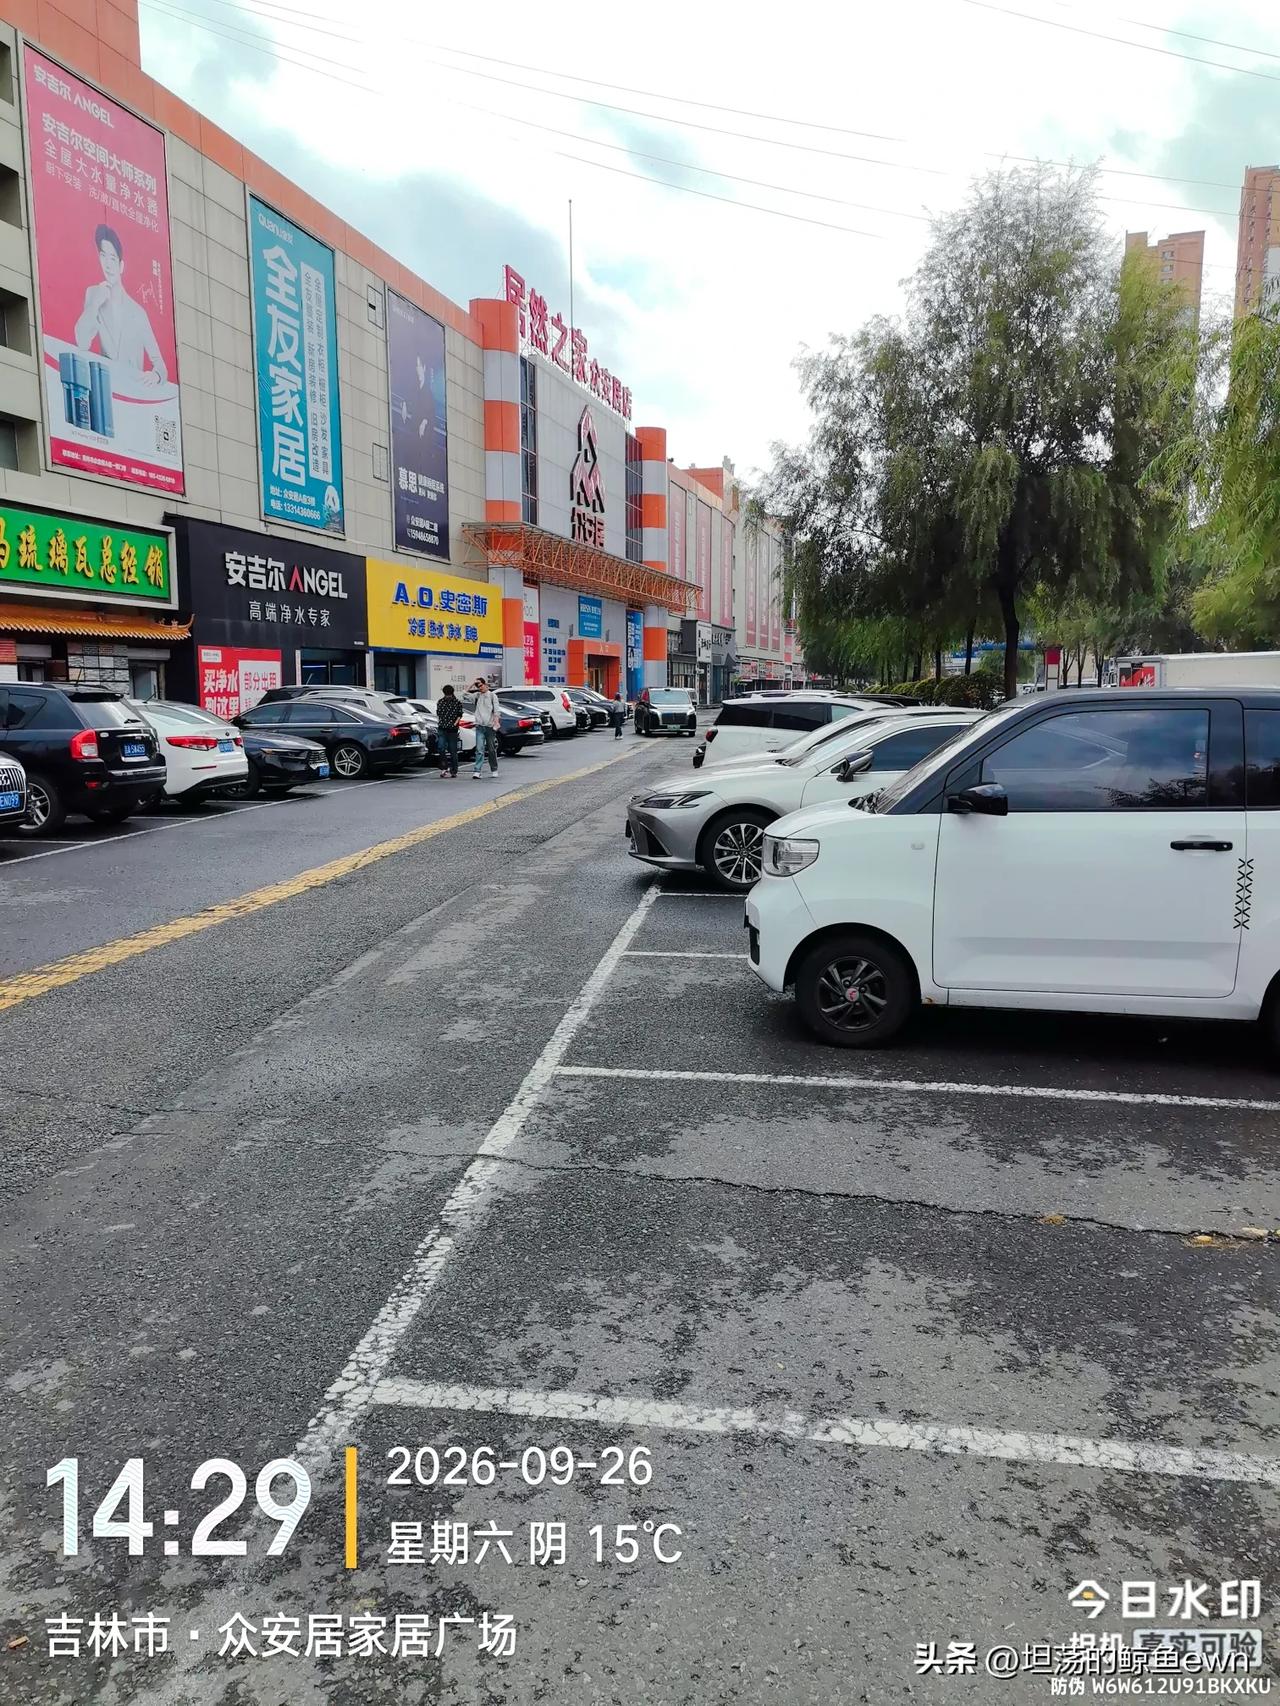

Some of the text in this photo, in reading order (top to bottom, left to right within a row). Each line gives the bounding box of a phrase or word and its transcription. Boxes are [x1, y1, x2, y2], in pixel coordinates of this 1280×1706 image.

[33, 64, 114, 128] 安吉尔 ANGEL
[42, 113, 157, 196] 安吉尔空间大师系列
[44, 138, 158, 216] 全屋大水量净水器
[262, 245, 306, 487] 全友家居
[399, 467, 418, 493] 慕思
[225, 551, 348, 600] 安吉尔 ANGEL
[392, 581, 488, 618] A.O.史密斯
[248, 600, 331, 627] 高端净水专家
[203, 668, 239, 693] 买净水
